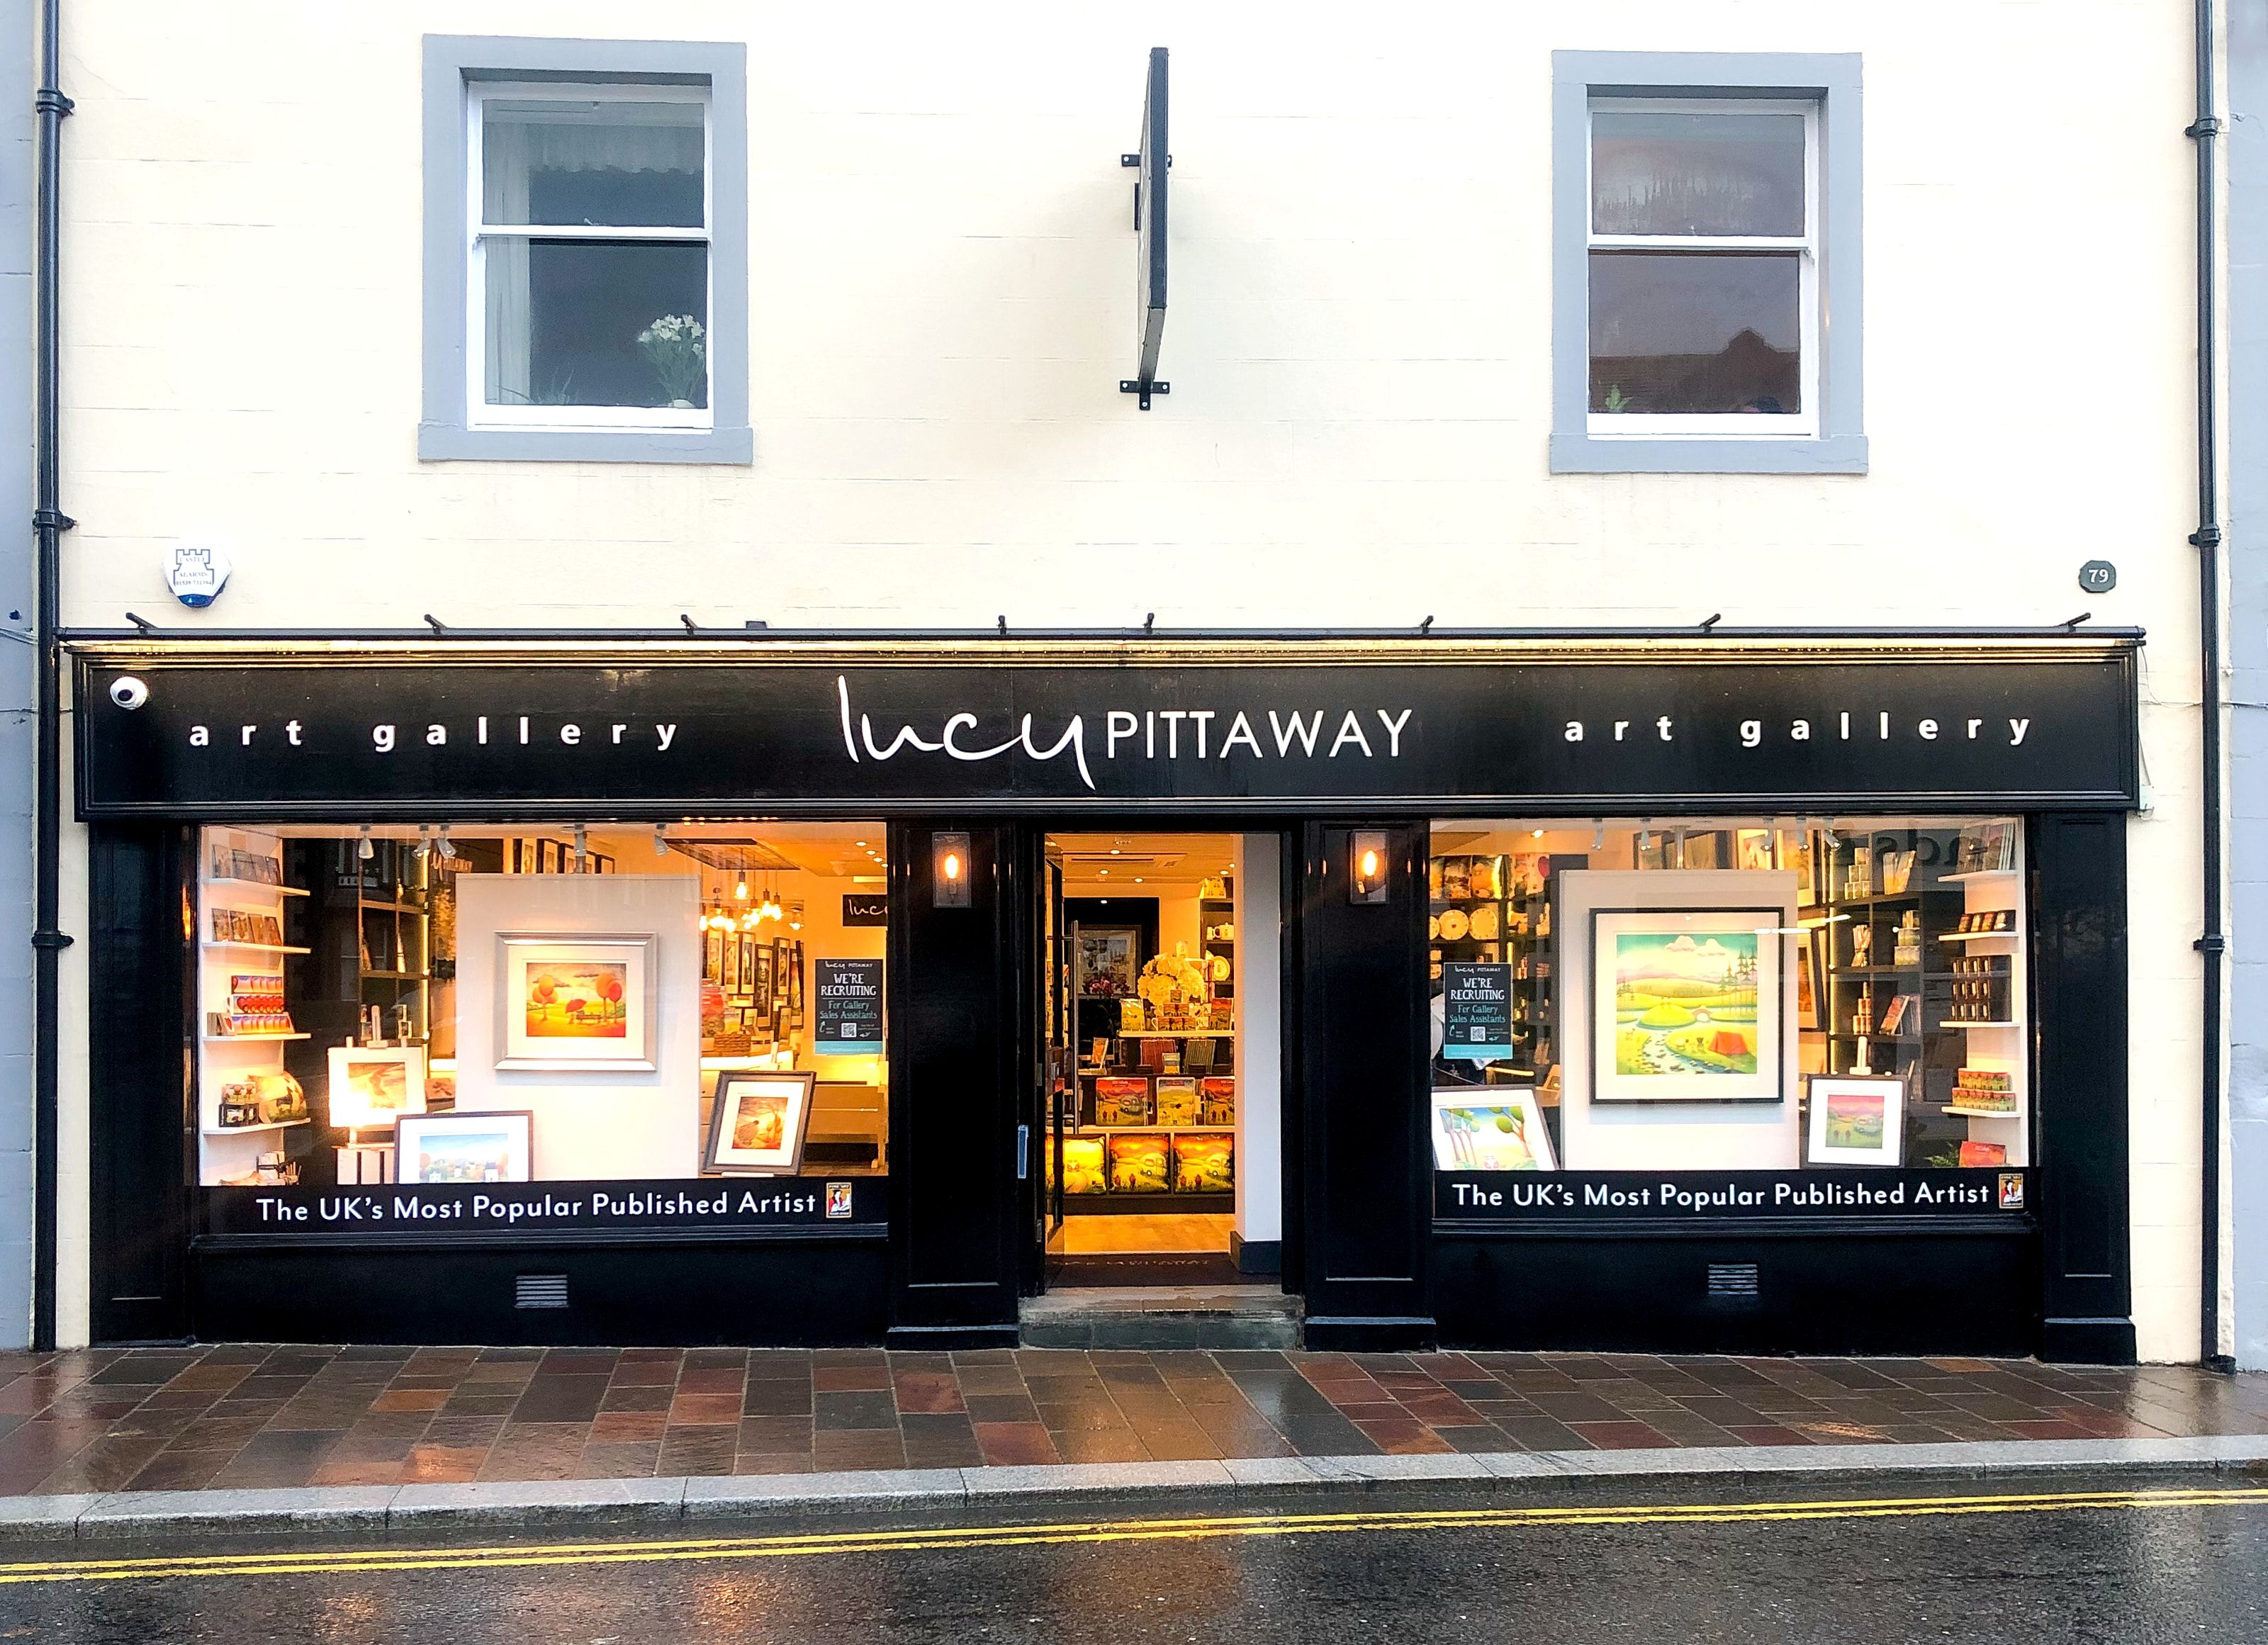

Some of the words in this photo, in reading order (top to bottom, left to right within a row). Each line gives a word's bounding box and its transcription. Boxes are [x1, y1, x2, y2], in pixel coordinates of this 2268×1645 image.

[2088, 568, 2109, 583] 79
[190, 721, 301, 746] art
[374, 717, 677, 752] gallery
[838, 674, 1096, 790] lucy
[1107, 709, 1413, 758] PITTAWAY
[1564, 716, 1672, 741] art
[1740, 712, 2030, 748] gallery
[848, 899, 887, 915] luc
[833, 972, 865, 984] WE'RE
[1463, 977, 1493, 989] WE'RE
[821, 985, 877, 996] RECRUITING
[1450, 989, 1505, 1000] RECRUITING
[828, 1001, 841, 1009] For
[843, 1001, 869, 1011] Gallery
[1457, 1004, 1470, 1014] For
[1471, 1004, 1498, 1015] Gallery
[819, 1011, 838, 1019] Sales
[840, 1011, 877, 1020] Assistants
[1449, 1015, 1467, 1023] Sales
[1469, 1014, 1506, 1023] Assistants
[1452, 1184, 1503, 1206] The
[1513, 1184, 1574, 1206] UK's
[1584, 1184, 1651, 1206] Most
[1661, 1183, 1765, 1211] Popular
[1775, 1181, 1904, 1205] Published
[1914, 1181, 1989, 1204] Artist
[255, 1198, 308, 1221] The
[320, 1196, 383, 1220] UK's
[394, 1196, 463, 1219] Most
[473, 1194, 583, 1223] Popular
[593, 1191, 727, 1216] Published
[735, 1191, 816, 1215] Artist
